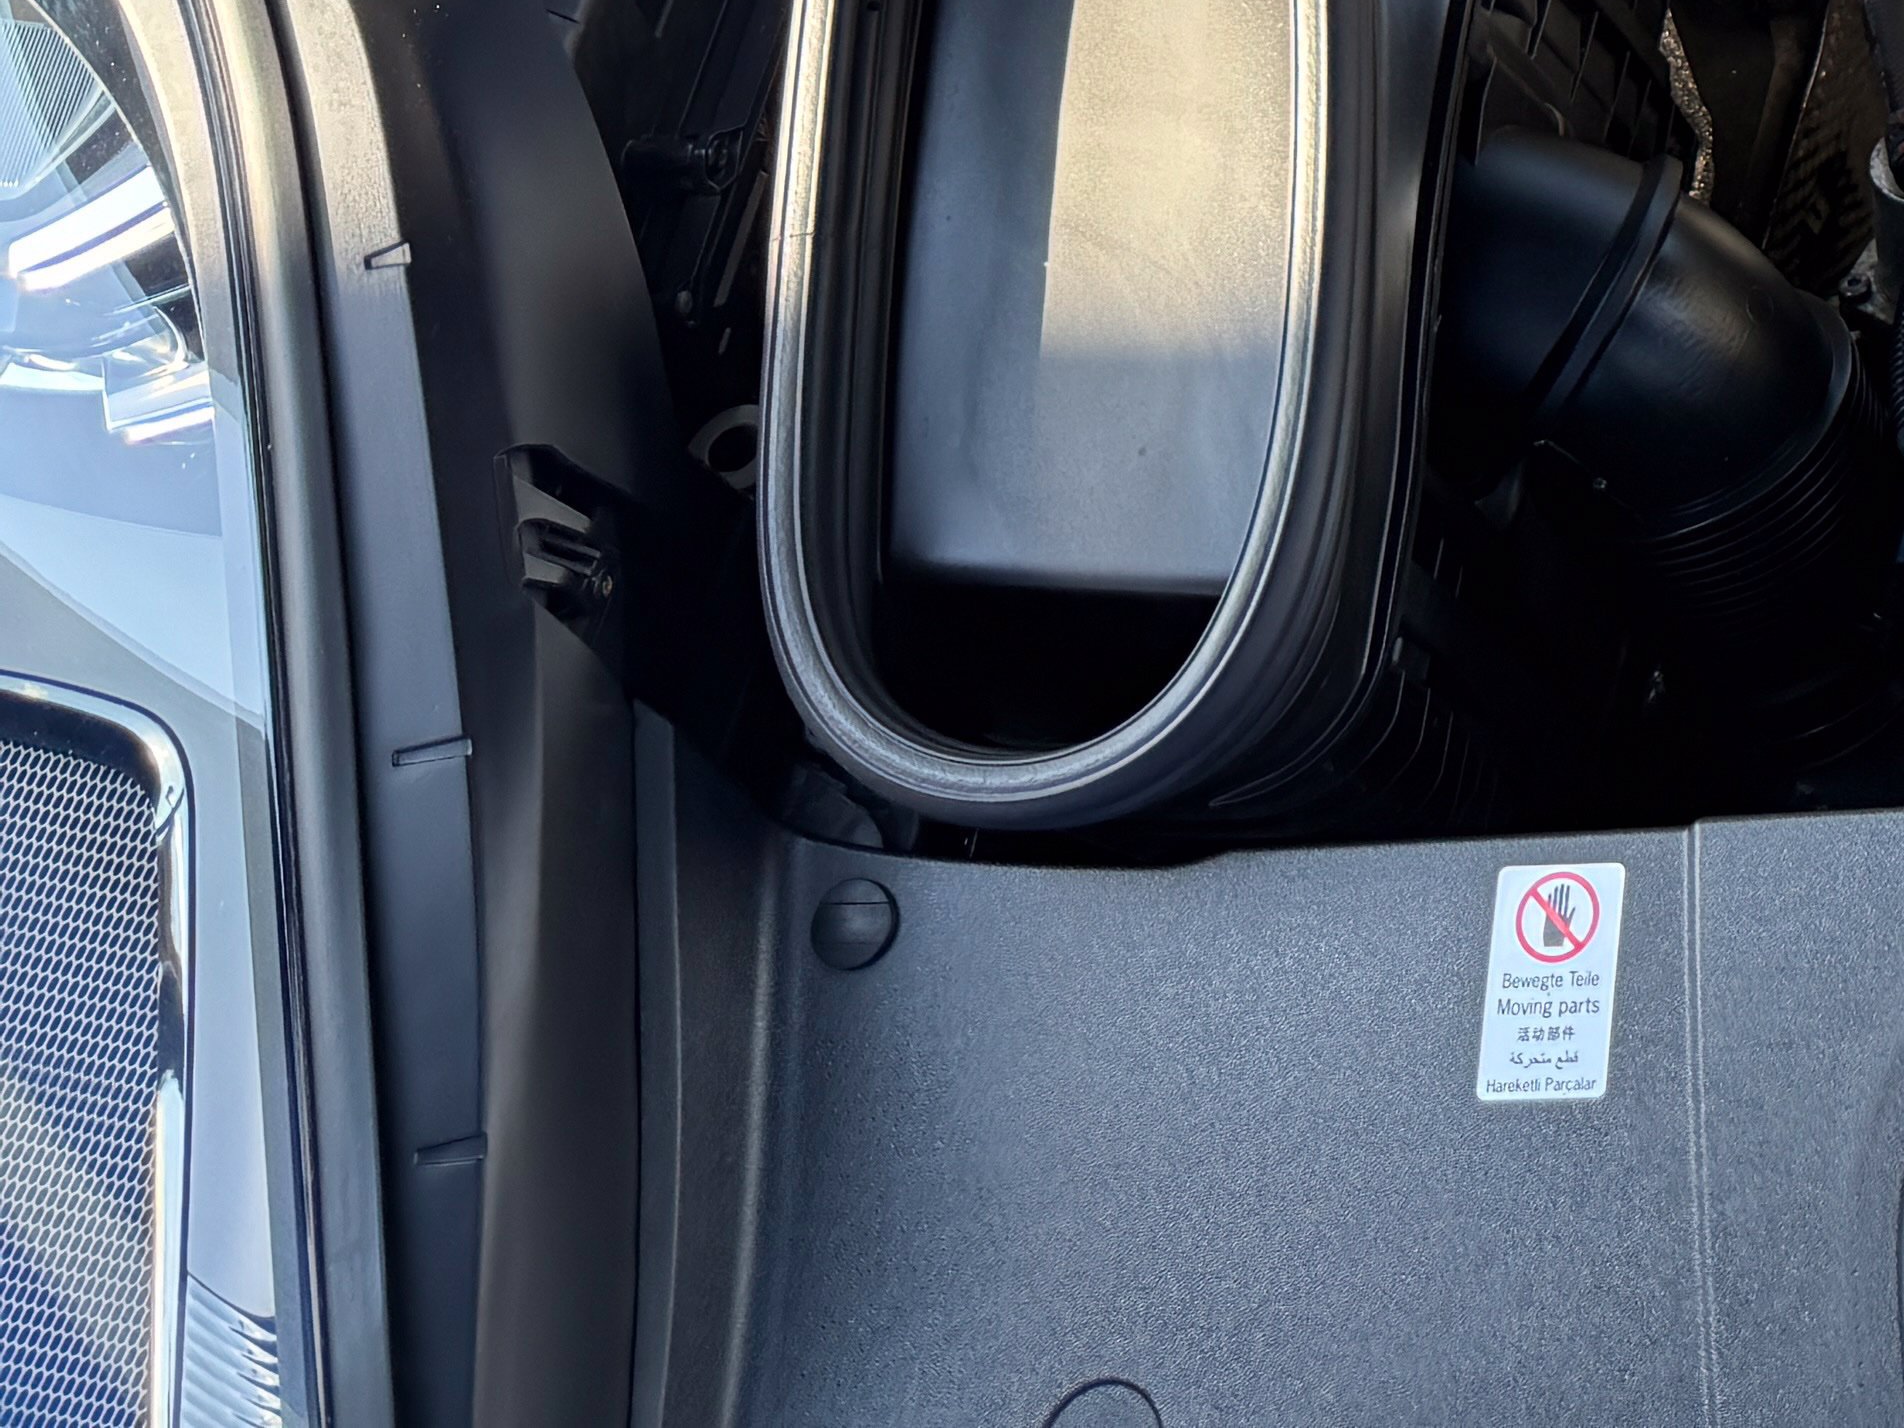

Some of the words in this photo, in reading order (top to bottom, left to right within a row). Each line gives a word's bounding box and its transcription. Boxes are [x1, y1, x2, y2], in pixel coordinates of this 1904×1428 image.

[1502, 972, 1563, 991] Bewegte
[1570, 970, 1600, 987] Teile
[1497, 998, 1553, 1018] Moving
[1558, 998, 1600, 1017] parts
[1517, 1026, 1575, 1042] 活动部件
[1554, 1051, 1578, 1069] قطع
[1486, 1077, 1541, 1094] Hareketli
[1545, 1078, 1597, 1094] Parçalar
